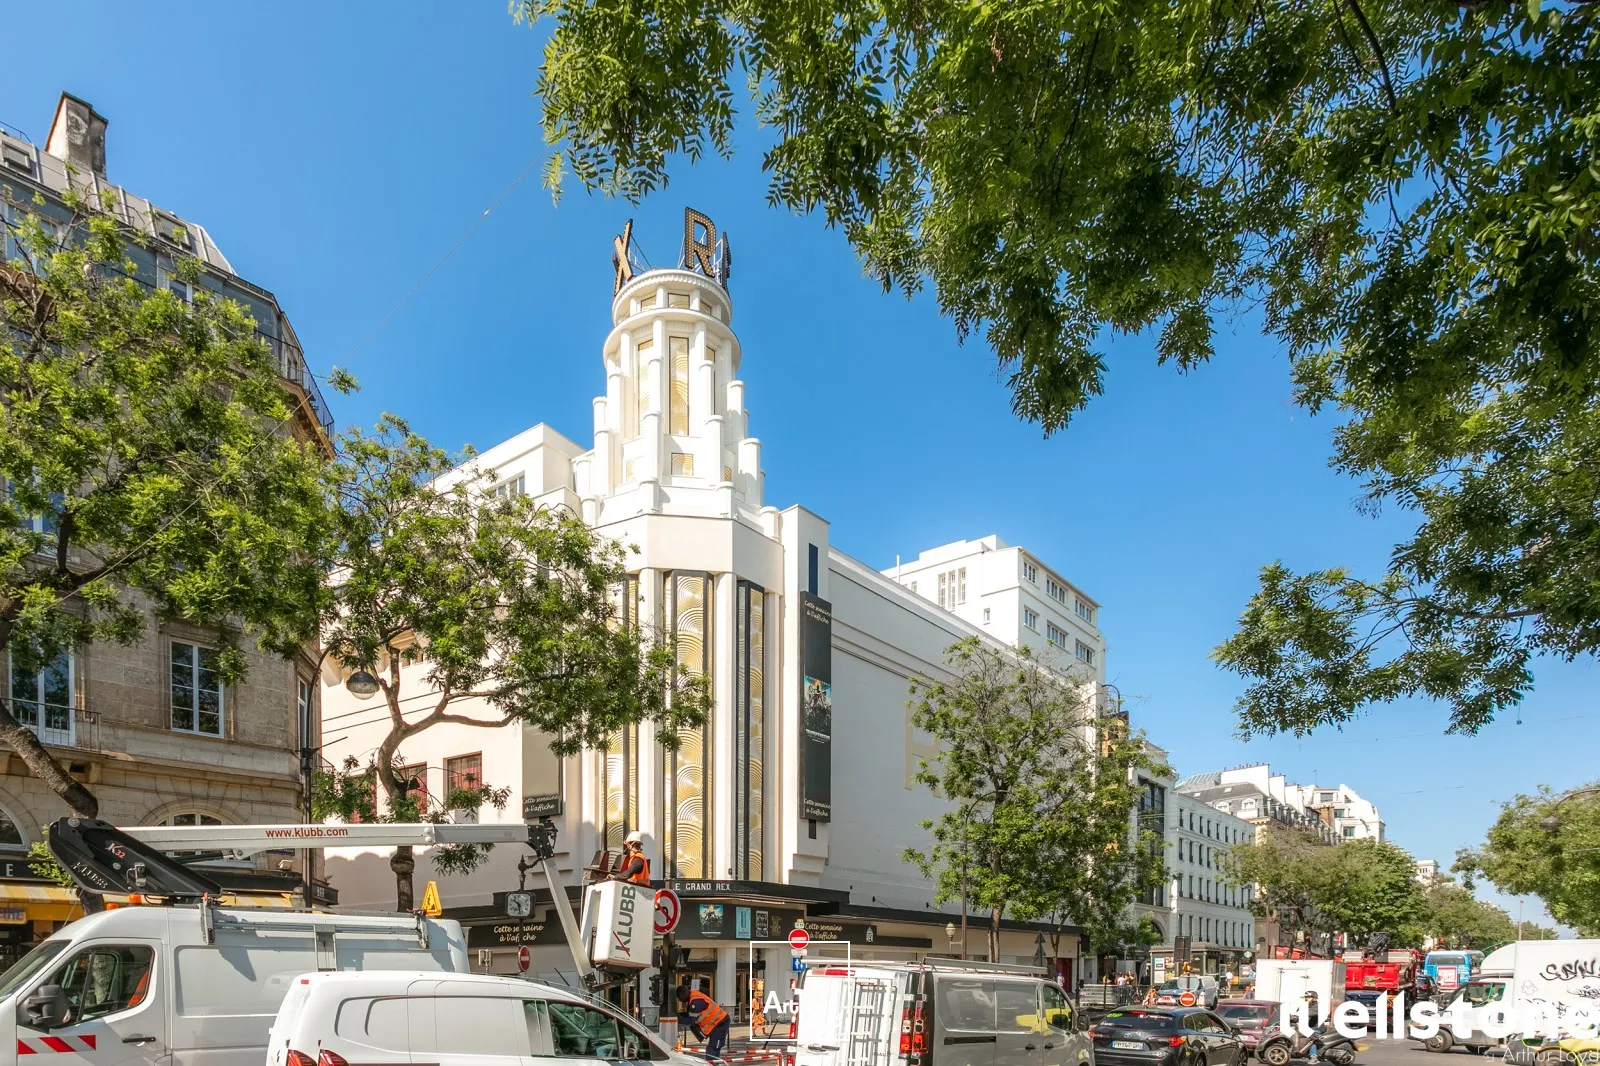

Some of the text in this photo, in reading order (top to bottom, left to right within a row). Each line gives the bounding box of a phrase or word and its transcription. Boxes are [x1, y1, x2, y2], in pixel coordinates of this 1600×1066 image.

[265, 827, 349, 837] www.klubb.com
[685, 882, 712, 891] GRAND
[716, 882, 731, 891] REX
[612, 885, 636, 958] KLUBB
[493, 924, 544, 933] Cette seaine
[805, 922, 843, 932] Cette semaine
